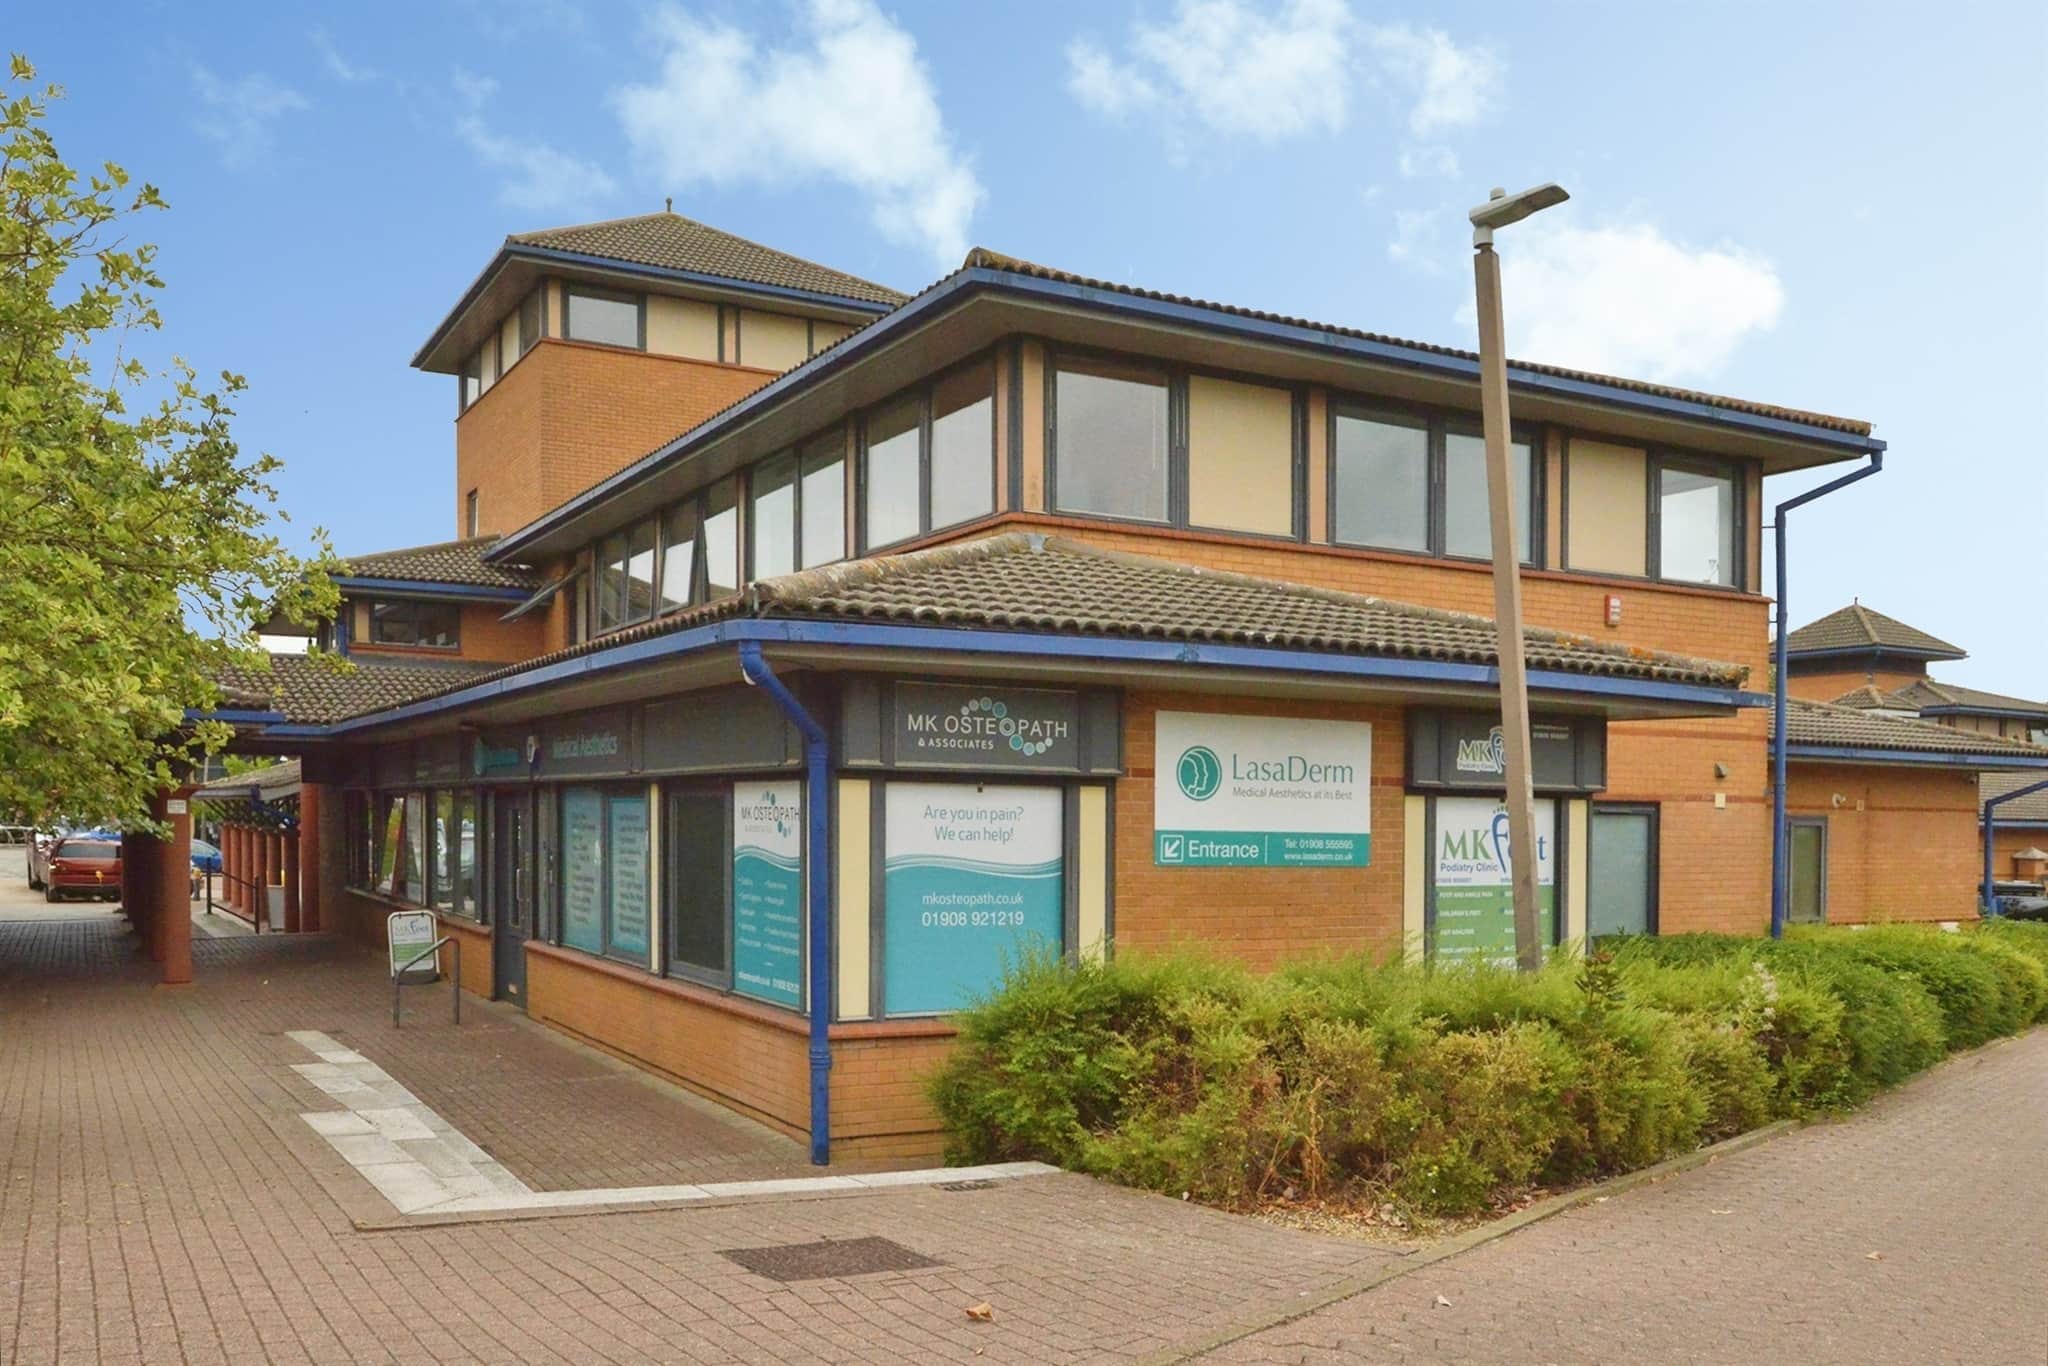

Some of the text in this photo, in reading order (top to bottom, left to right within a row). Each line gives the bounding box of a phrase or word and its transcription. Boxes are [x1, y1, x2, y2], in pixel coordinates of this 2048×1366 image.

[907, 713, 1068, 738] MK OSTEOPATH
[928, 738, 994, 750] ASSOCIATES
[1458, 739, 1493, 761] MK
[1232, 753, 1354, 784] LasaDerm
[1232, 786, 1267, 798] Medical
[1268, 788, 1312, 800] Aesthetics
[1335, 790, 1353, 801] Best
[923, 805, 1025, 824] Are you in pain?
[935, 825, 1014, 845] We can help!
[1299, 839, 1324, 849] 01908
[1441, 829, 1492, 860] MK
[1188, 839, 1260, 859] Entrance
[1440, 862, 1499, 874] Podiatry Clinic
[922, 891, 1024, 908] mkosteopath.co.uk
[922, 911, 1025, 927] 01908 921219
